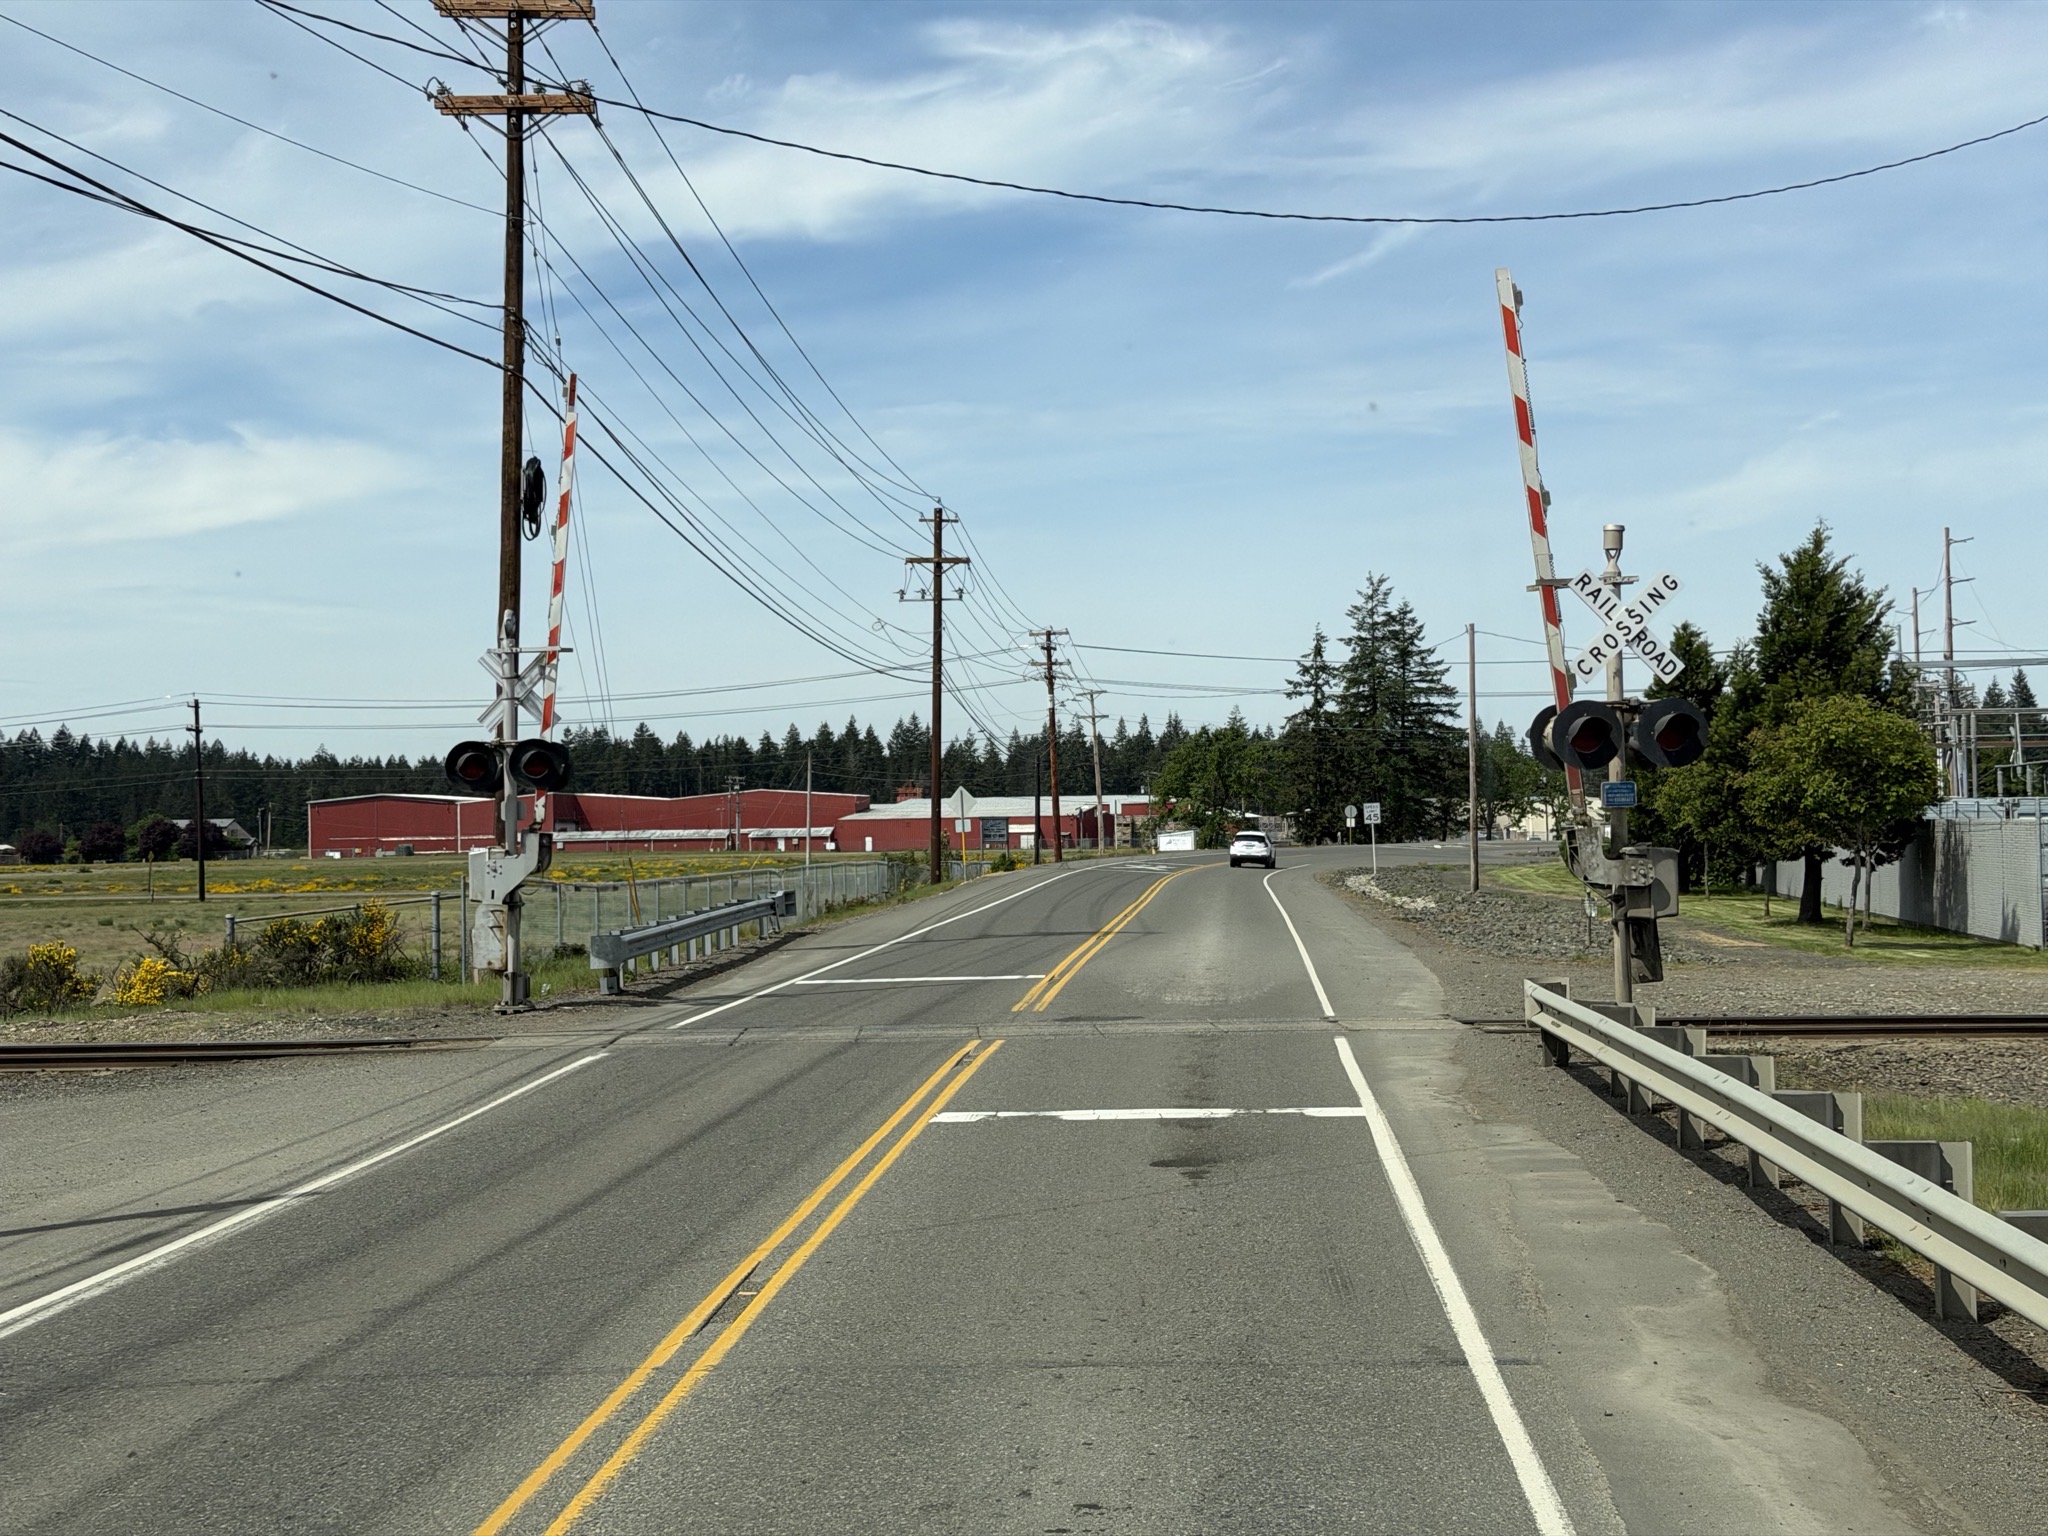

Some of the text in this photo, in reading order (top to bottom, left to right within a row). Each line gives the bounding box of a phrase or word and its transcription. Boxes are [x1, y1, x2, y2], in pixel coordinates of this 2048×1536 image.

[1574, 573, 1677, 676] RAIL ROAD
[1577, 575, 1678, 675] CROSSING
